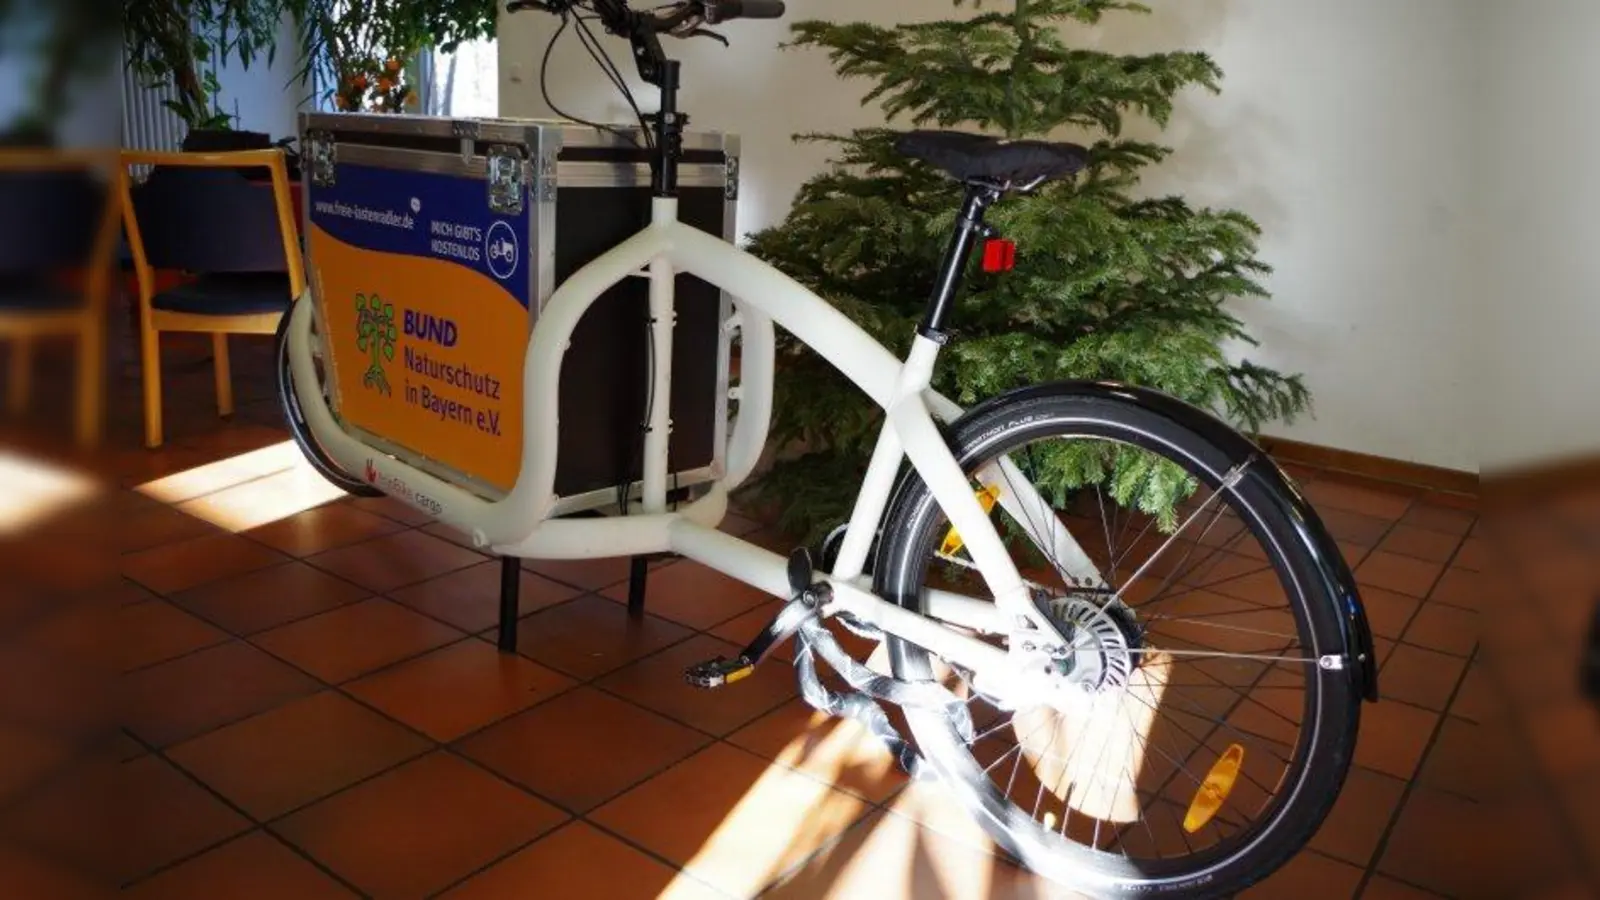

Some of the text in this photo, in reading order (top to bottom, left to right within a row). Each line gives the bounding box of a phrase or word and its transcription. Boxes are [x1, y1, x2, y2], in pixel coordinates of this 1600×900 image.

[431, 220, 481, 242] MICH GIBT'S
[431, 239, 480, 261] KOSTENLOS
[404, 308, 458, 347] BUND
[404, 344, 501, 400] Naturschutz
[405, 377, 502, 437] in Bayern e.V.
[415, 493, 443, 515] cargo
